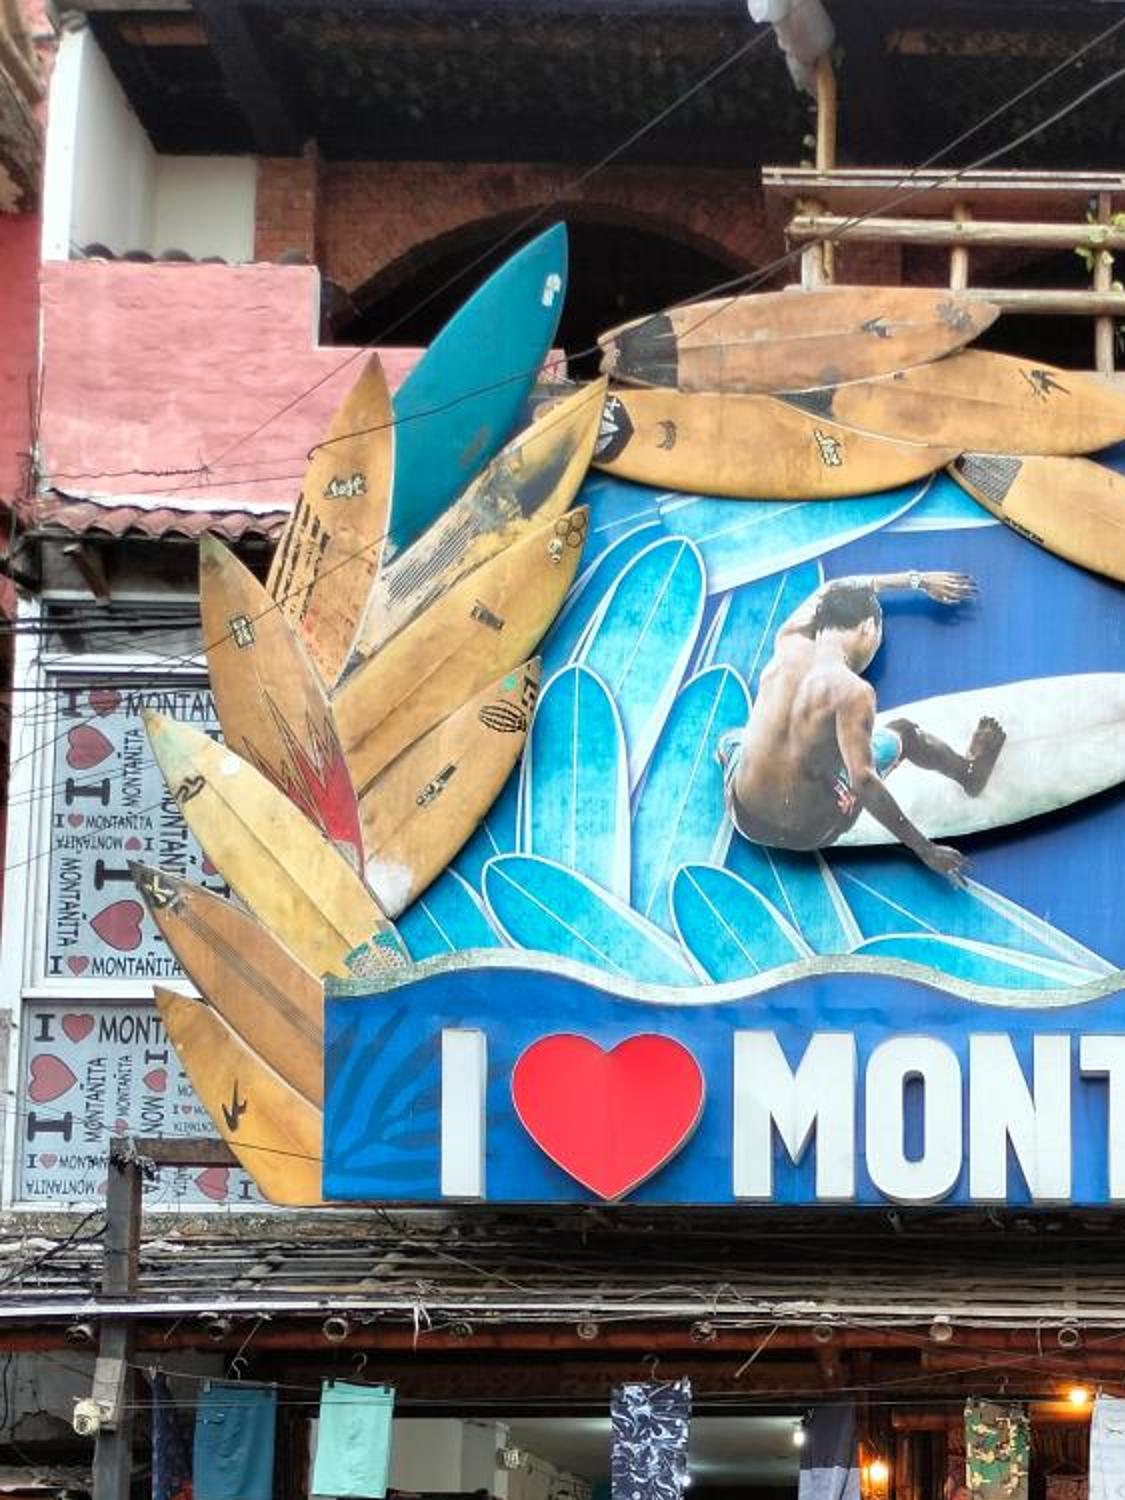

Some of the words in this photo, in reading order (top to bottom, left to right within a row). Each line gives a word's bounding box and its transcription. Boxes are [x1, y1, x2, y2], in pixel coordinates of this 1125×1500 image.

[56, 857, 87, 946] MONTAÑITA
[50, 956, 63, 974] I
[34, 1013, 55, 1042] I
[440, 1028, 488, 1198] I
